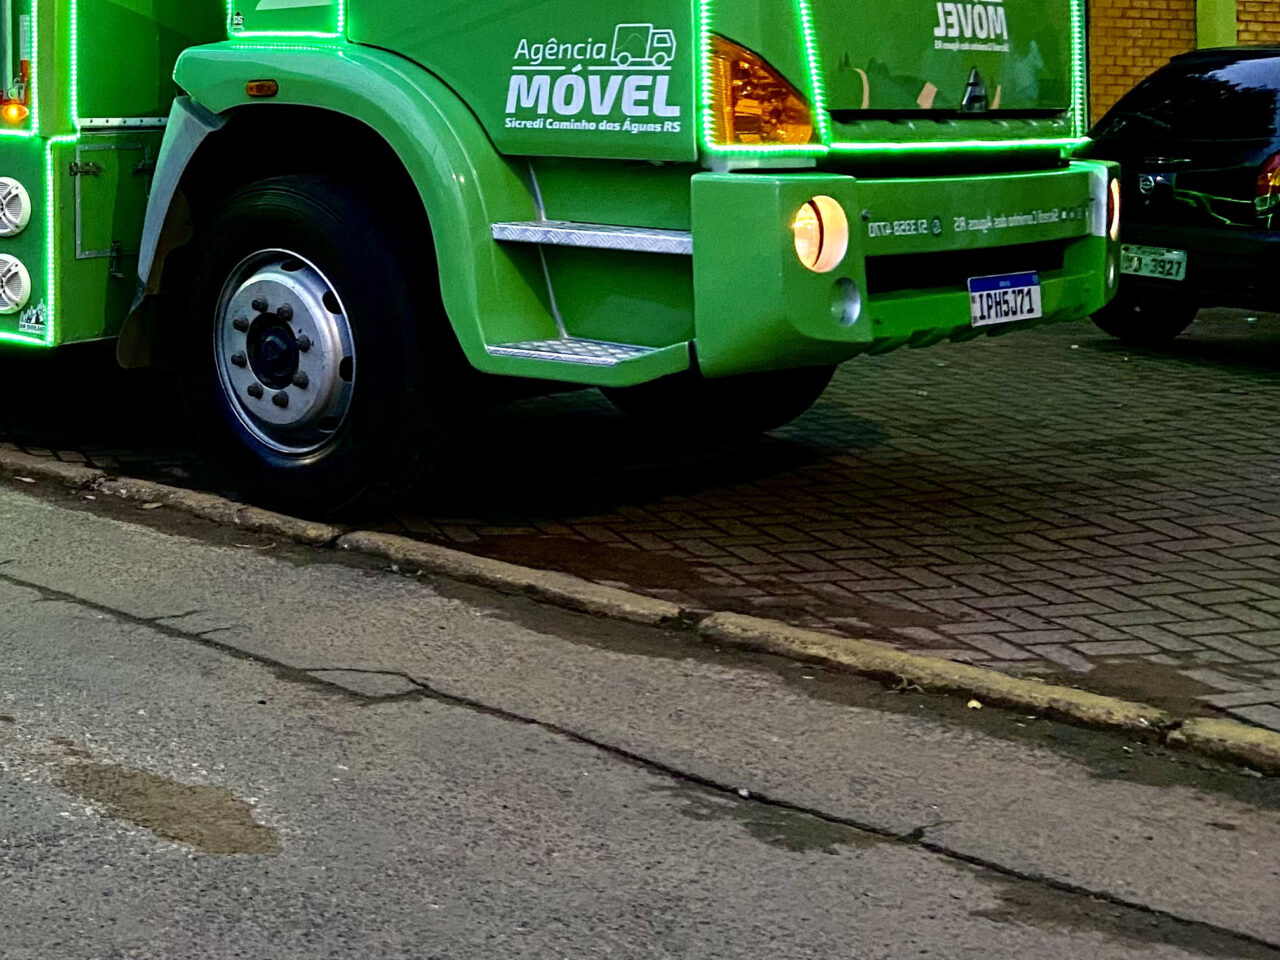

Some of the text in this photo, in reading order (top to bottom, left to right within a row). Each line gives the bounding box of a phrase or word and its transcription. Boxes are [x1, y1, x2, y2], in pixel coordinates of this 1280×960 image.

[514, 37, 607, 65] Agência
[505, 63, 680, 117] MÓVEL
[504, 118, 681, 134] Sicredi Caminho das Águas RS
[978, 287, 1035, 320] IPH5J71
